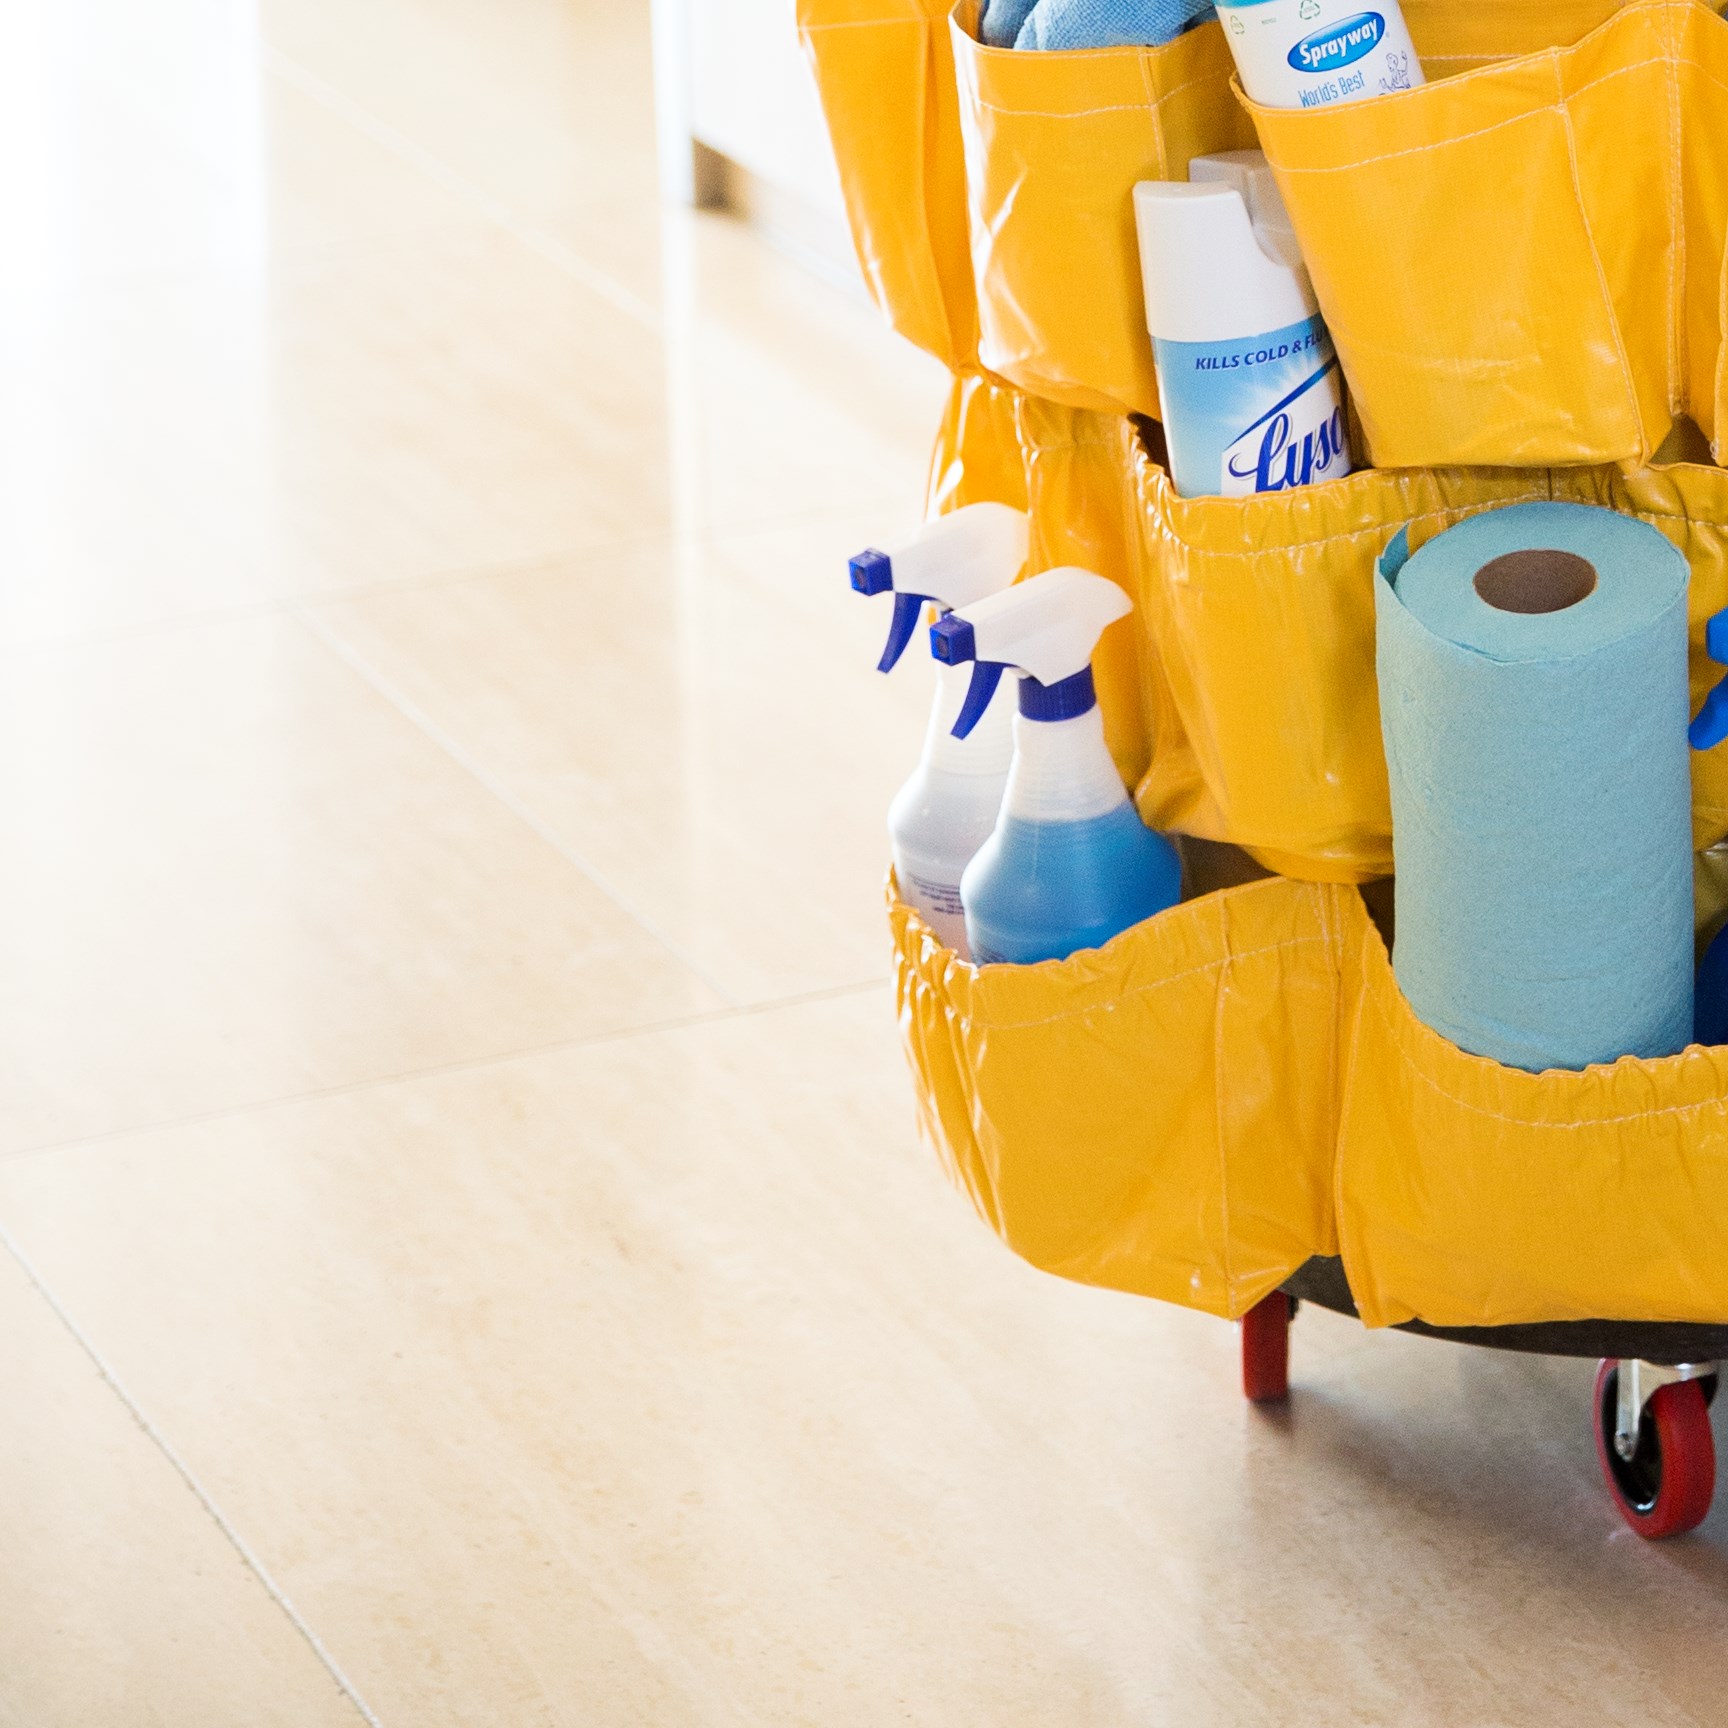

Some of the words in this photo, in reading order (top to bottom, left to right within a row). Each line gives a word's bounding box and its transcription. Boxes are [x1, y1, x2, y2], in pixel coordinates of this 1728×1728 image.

[1299, 18, 1378, 68] Sprayway
[1298, 81, 1338, 107] World's
[1338, 69, 1366, 96] Best
[1195, 354, 1240, 370] KILLS
[1244, 344, 1289, 366] COLD
[1292, 339, 1302, 354] &
